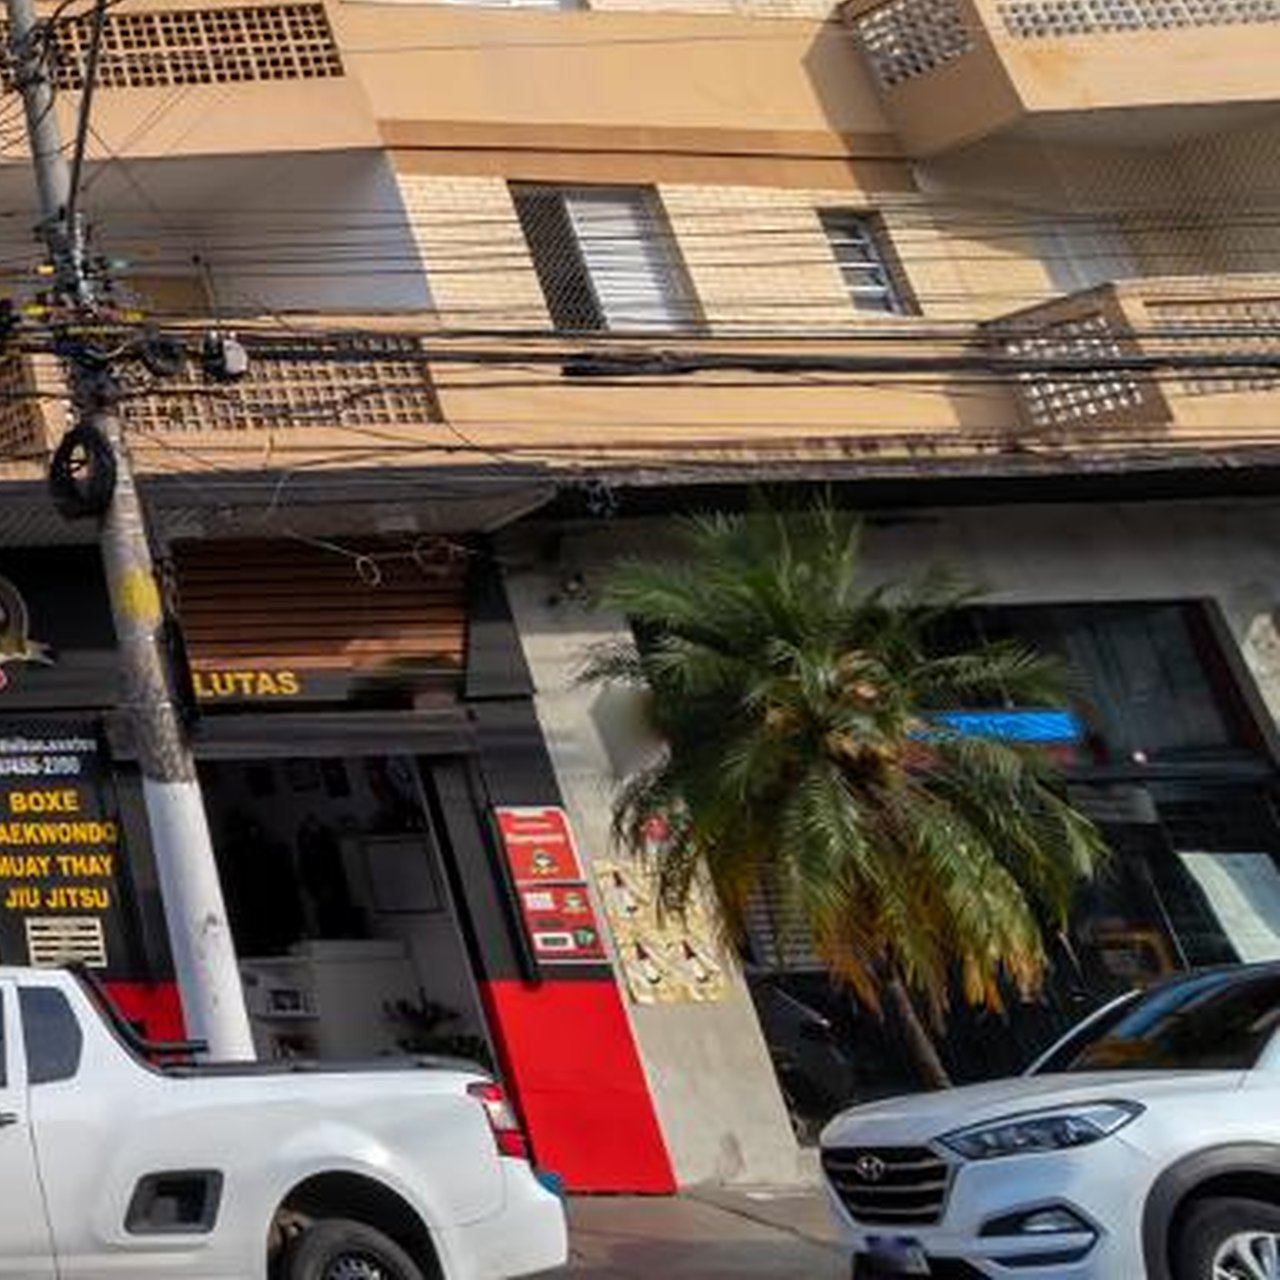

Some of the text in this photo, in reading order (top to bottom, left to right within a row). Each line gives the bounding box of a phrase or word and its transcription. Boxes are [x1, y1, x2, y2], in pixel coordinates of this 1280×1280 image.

[192, 671, 299, 697] LUTAS
[9, 789, 80, 812] BOXE
[56, 854, 113, 877] THAY
[5, 888, 110, 909] JIU JITSU
